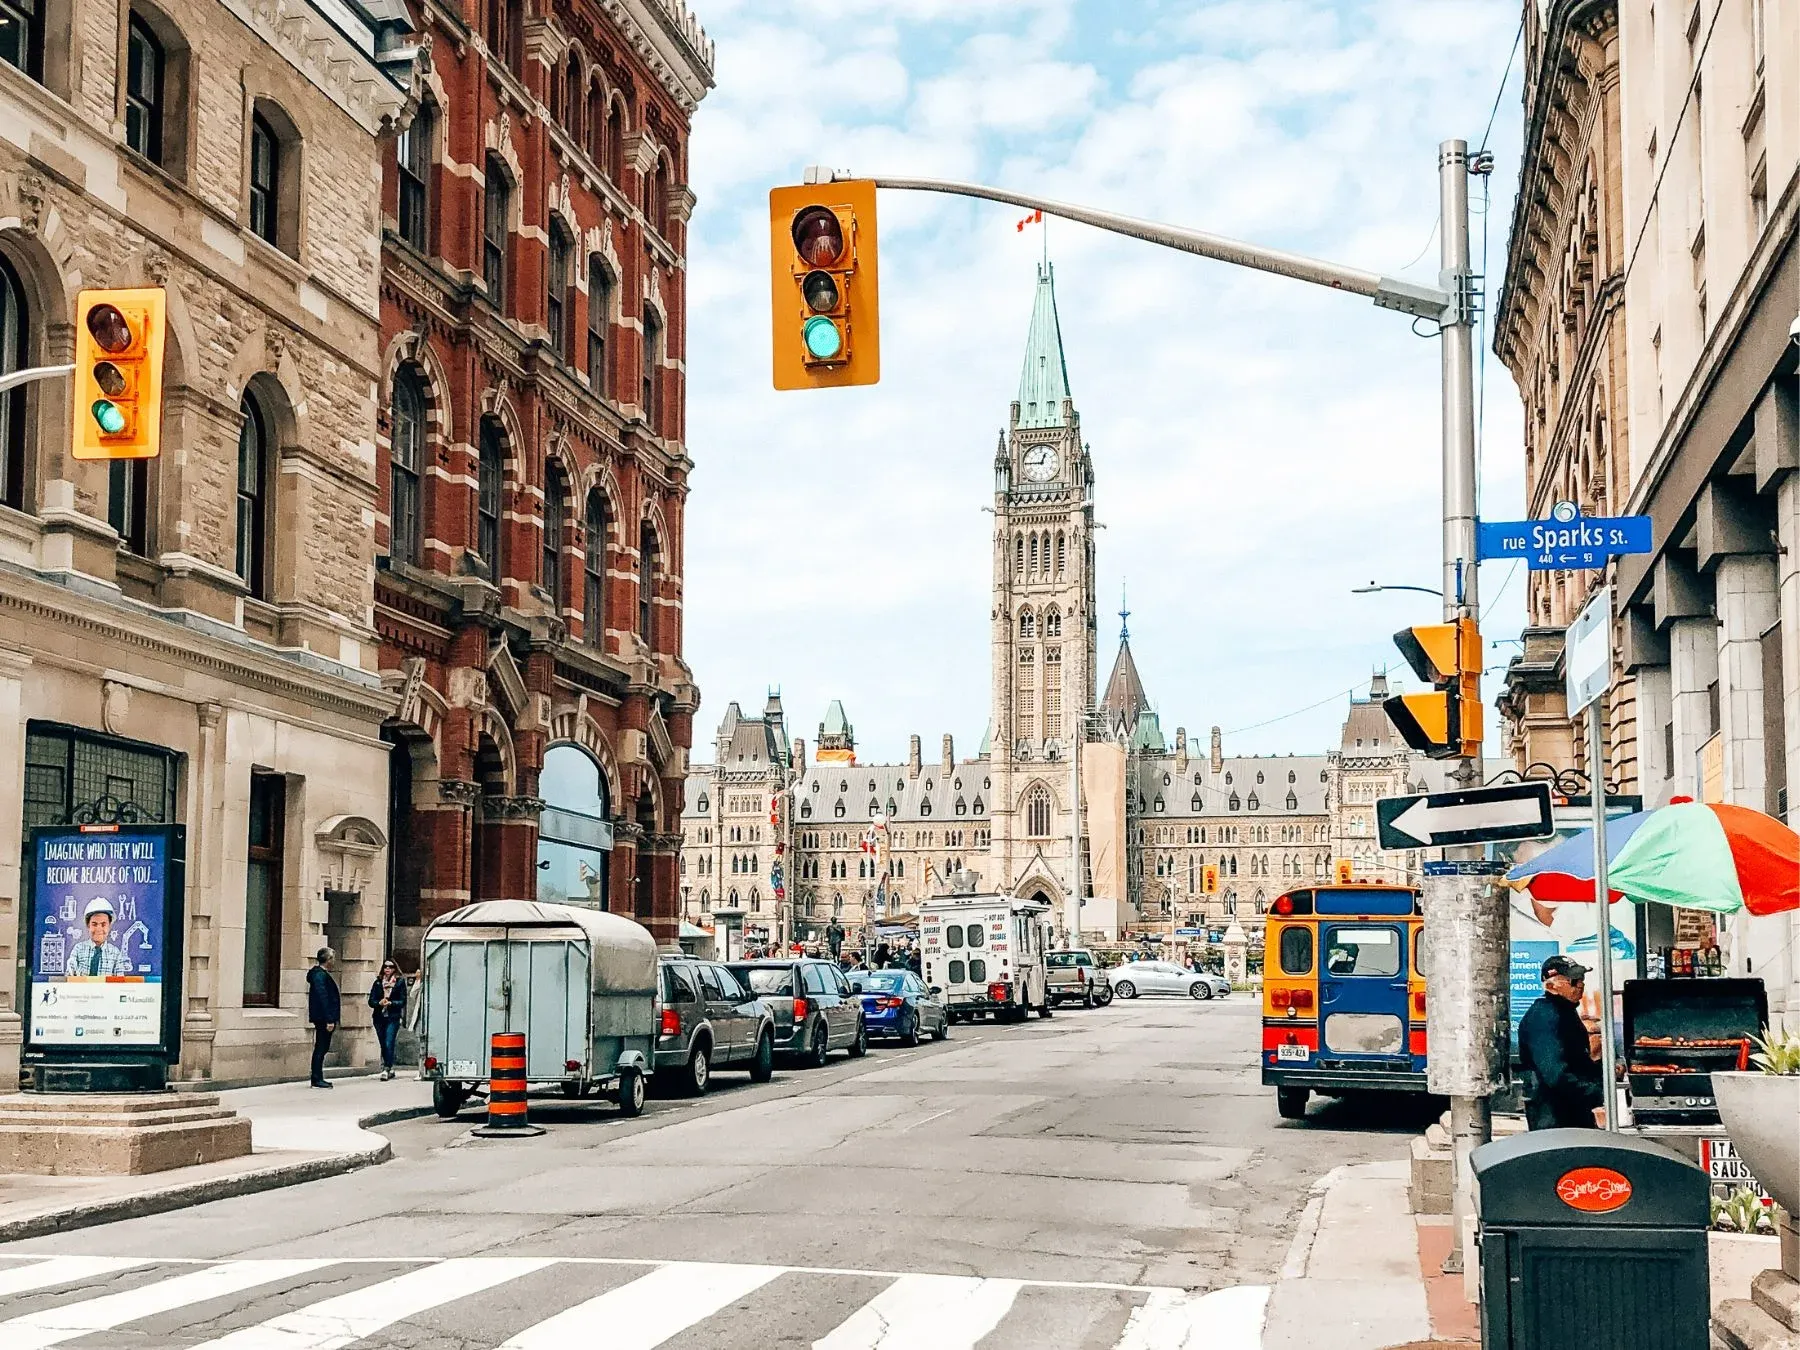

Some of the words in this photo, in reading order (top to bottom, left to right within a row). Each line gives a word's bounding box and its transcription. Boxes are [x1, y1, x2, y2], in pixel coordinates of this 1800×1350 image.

[1503, 537, 1526, 550] rue
[1532, 521, 1604, 554] Sparks
[1609, 529, 1628, 545] St.
[1538, 554, 1554, 564] 440
[1583, 553, 1593, 562] 93
[44, 841, 84, 860] IMAGINE
[86, 842, 106, 860] WHO
[109, 842, 130, 860] THEY
[132, 842, 155, 860] WILL
[46, 866, 79, 884] BECOME
[80, 866, 117, 884] BECAUSE
[118, 866, 131, 884] OF
[132, 865, 158, 884] YOU...
